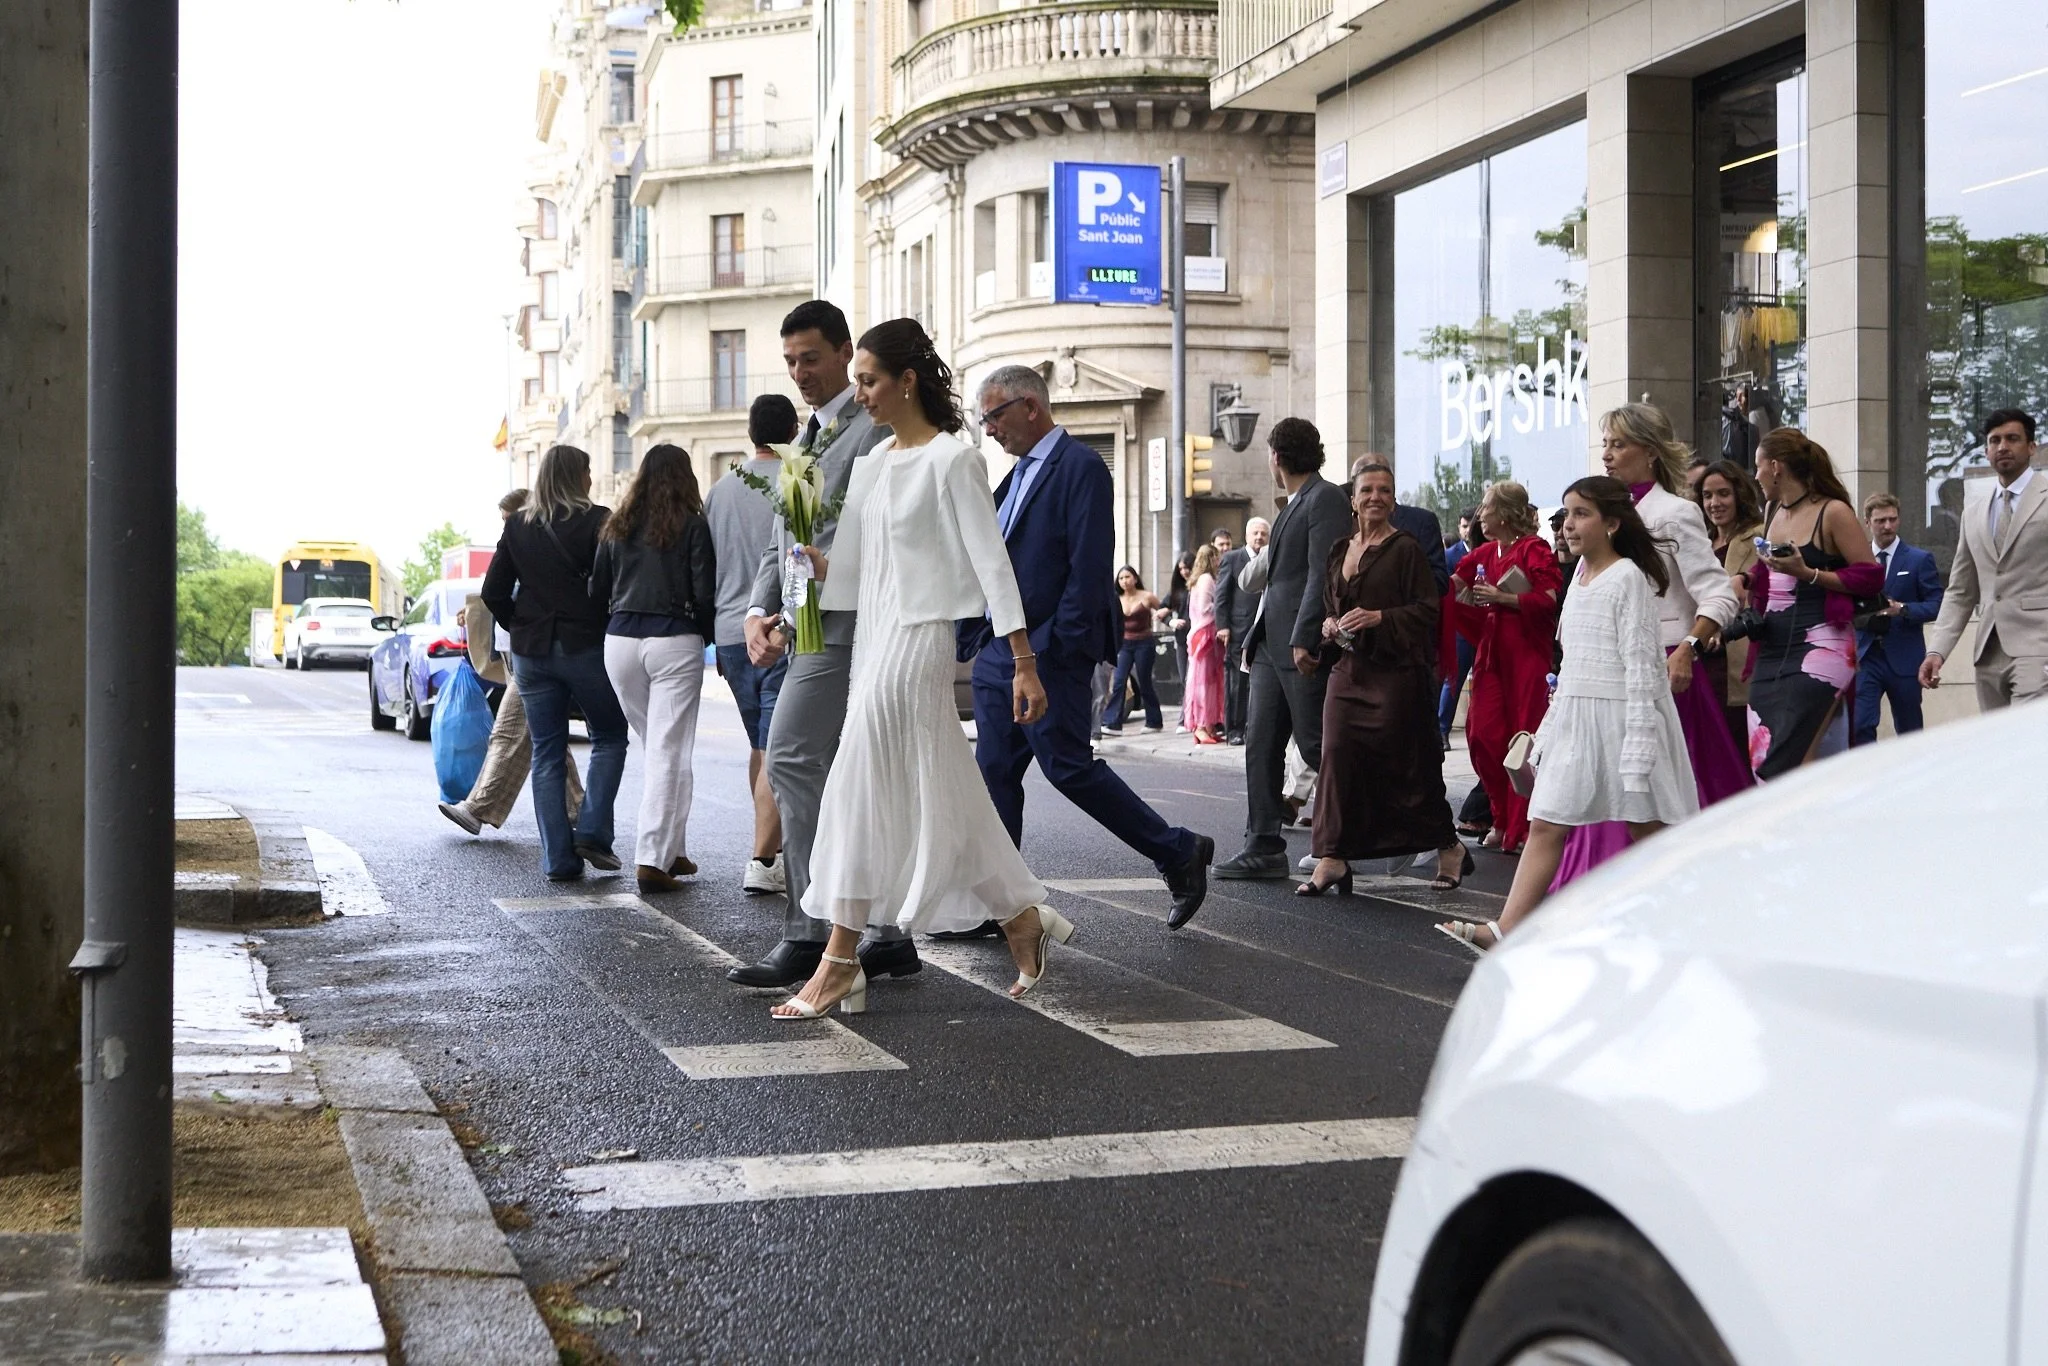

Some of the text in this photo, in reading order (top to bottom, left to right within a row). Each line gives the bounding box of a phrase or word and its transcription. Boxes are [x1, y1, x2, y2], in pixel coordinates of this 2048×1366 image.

[1078, 170, 1123, 225] P
[1100, 212, 1141, 228] Públic
[1078, 229, 1144, 245] Sant Joan
[1091, 268, 1138, 284] LLIURE
